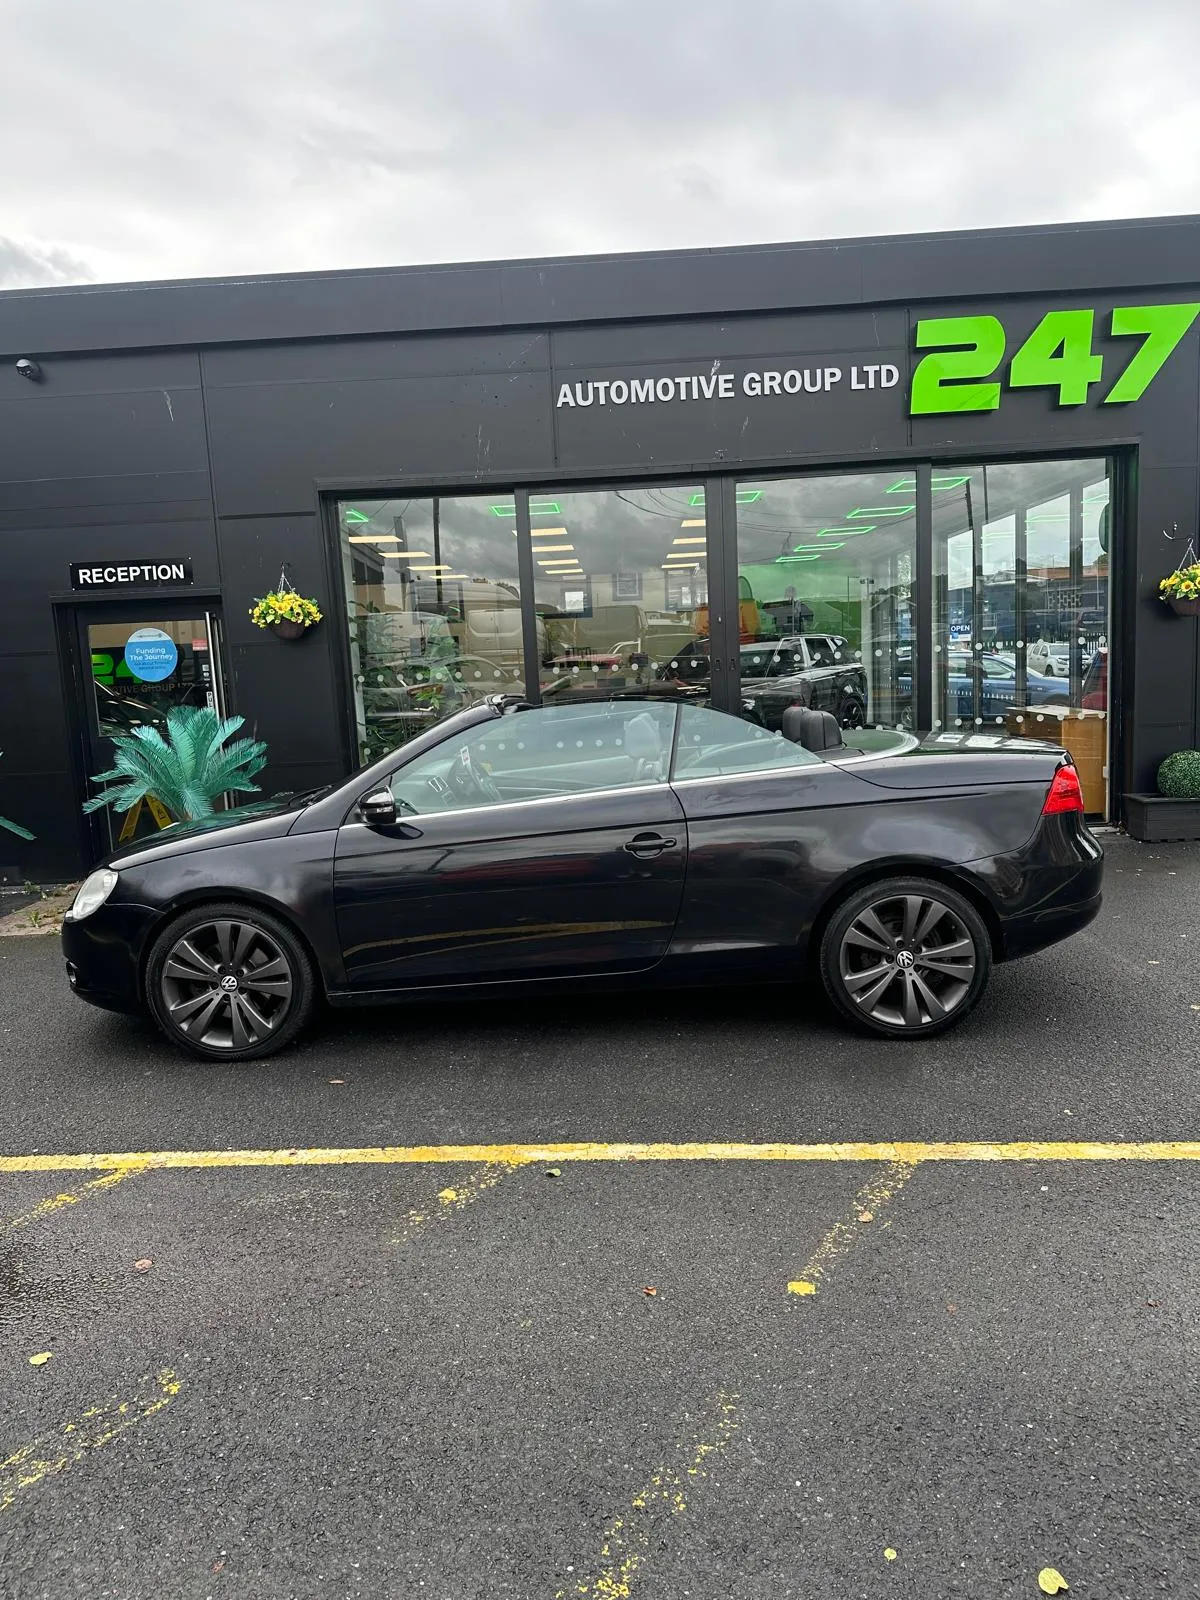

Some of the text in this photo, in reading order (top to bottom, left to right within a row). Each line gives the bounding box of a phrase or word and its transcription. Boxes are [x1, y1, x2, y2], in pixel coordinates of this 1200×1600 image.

[910, 303, 1200, 415] 247
[556, 364, 900, 408] AUTOMOTIVE GROUP LTD
[78, 564, 185, 584] RECEPTION
[135, 647, 166, 655] Funding
[144, 653, 174, 661] Journey
